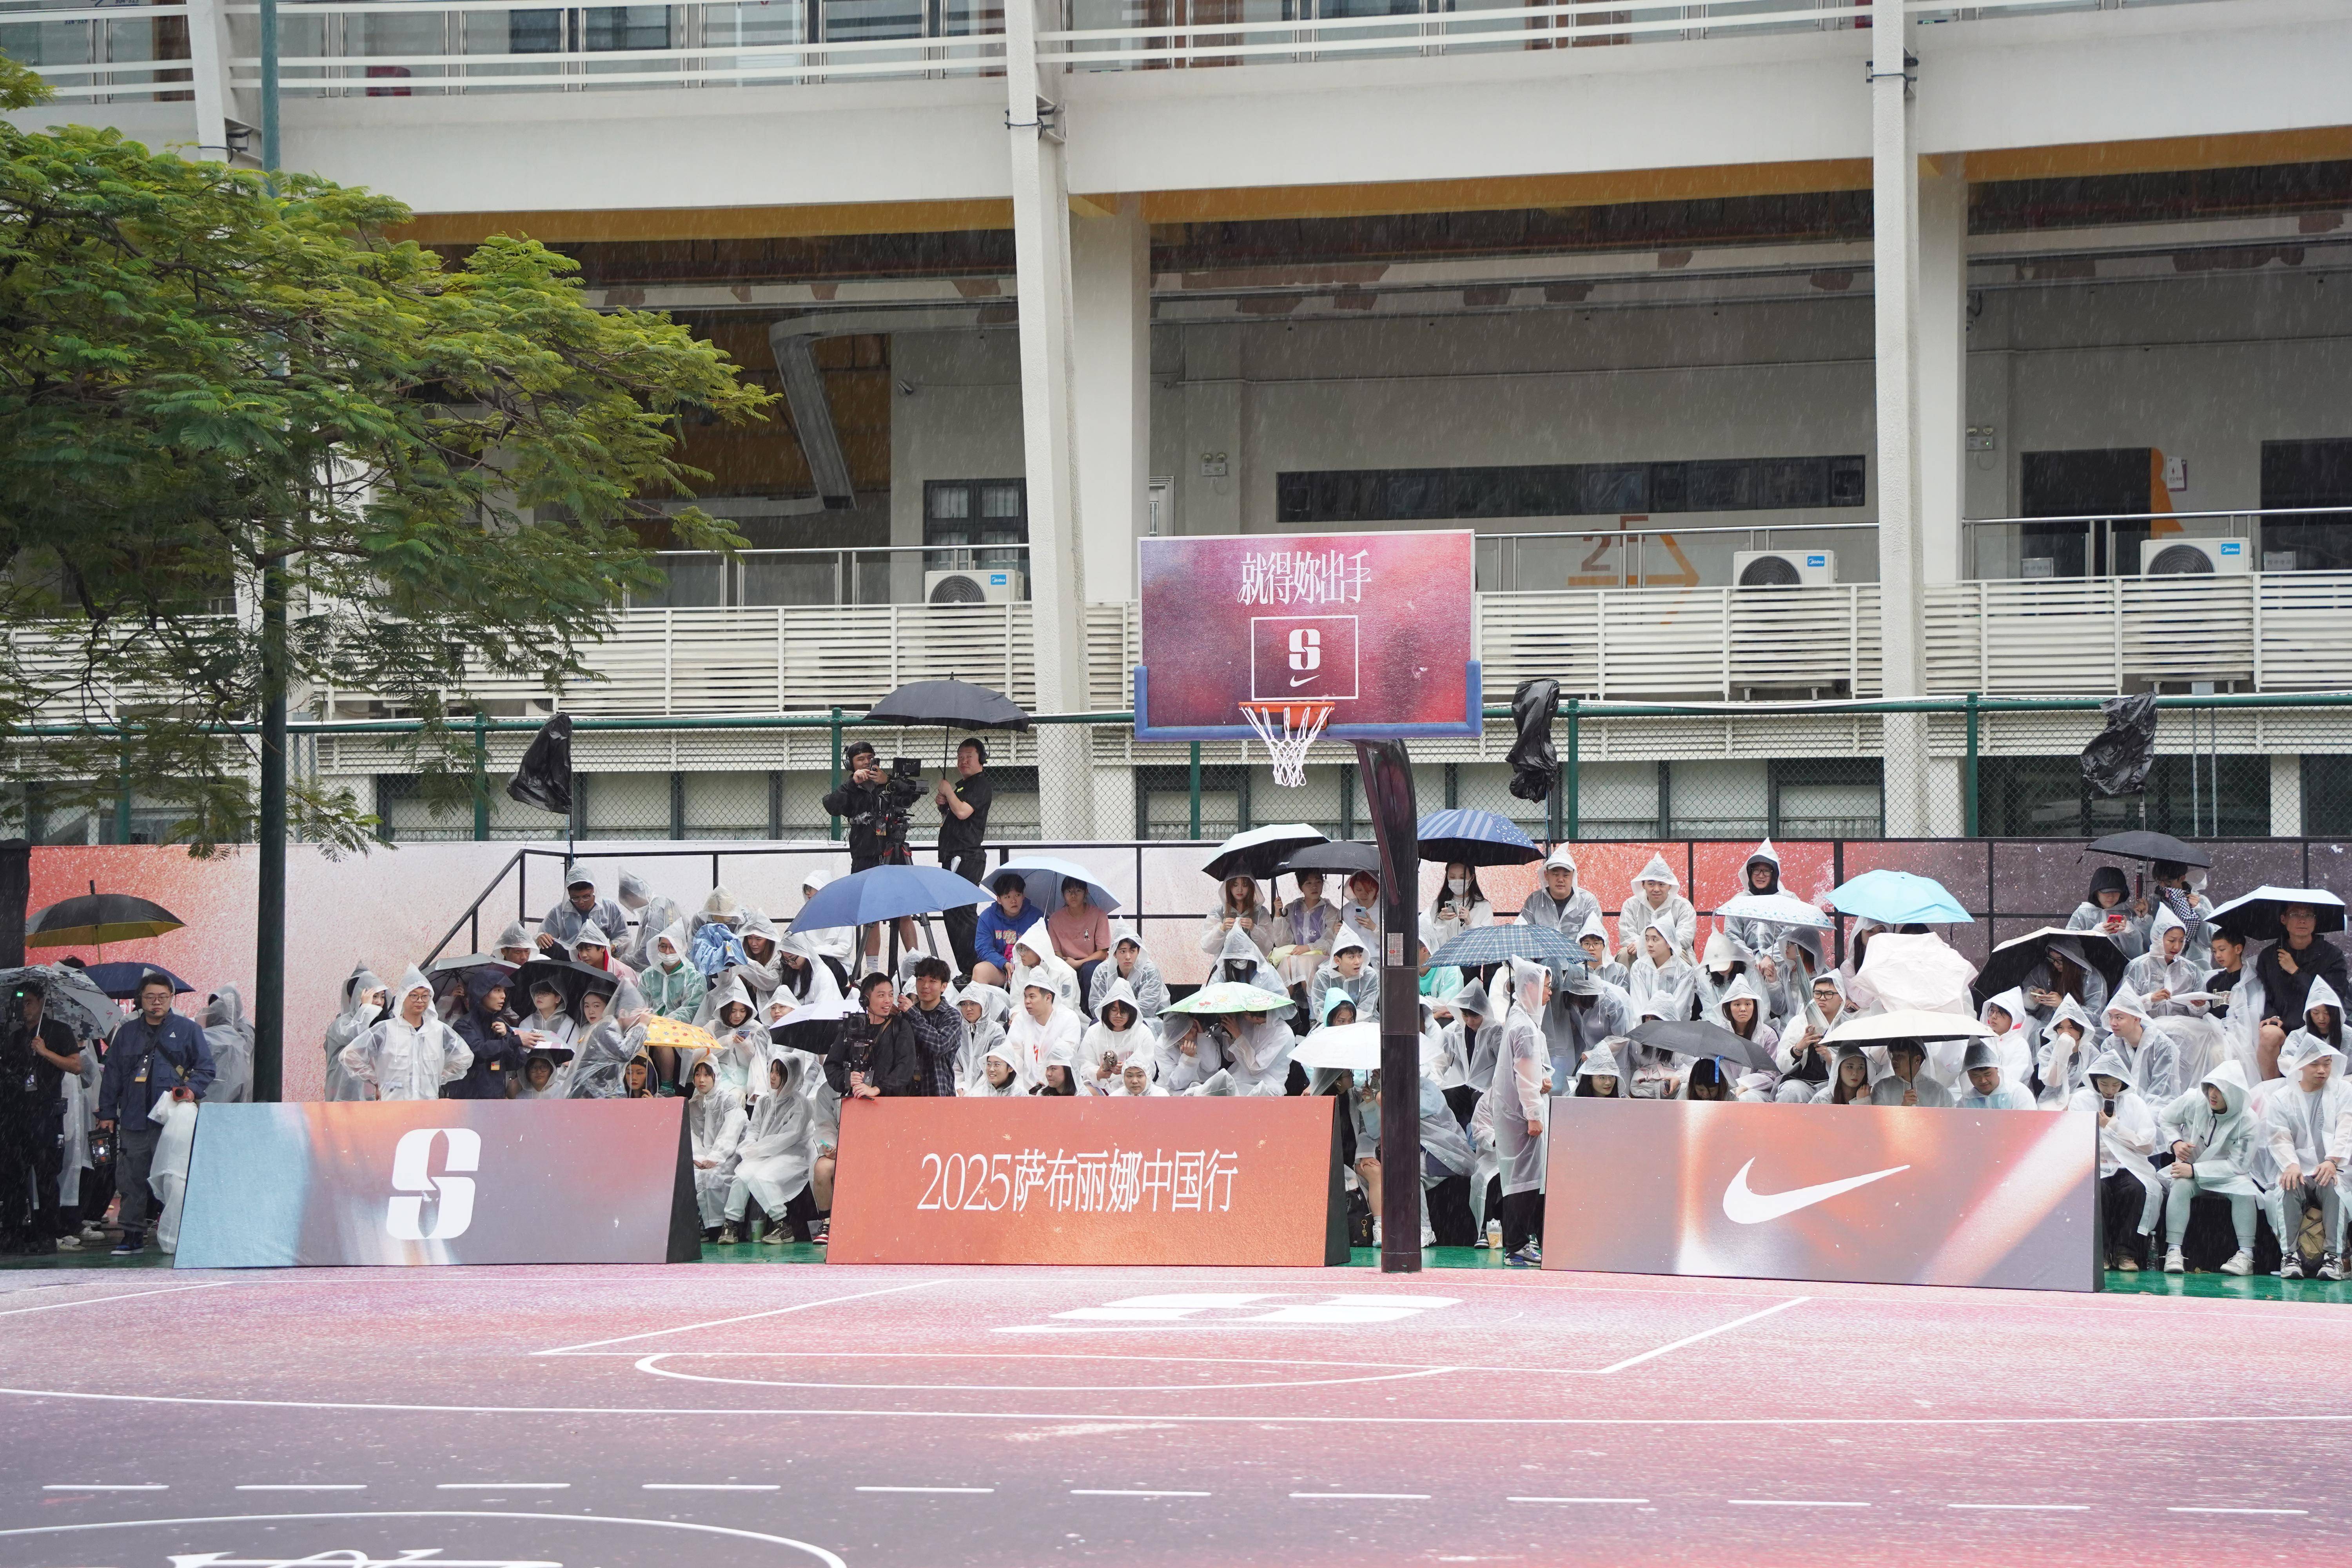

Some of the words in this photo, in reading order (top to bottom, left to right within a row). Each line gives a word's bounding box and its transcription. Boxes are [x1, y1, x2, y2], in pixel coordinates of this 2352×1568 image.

[1237, 549, 1372, 605] 就得妳出手
[917, 1148, 1238, 1212] 2025萨布丽娜中国行
